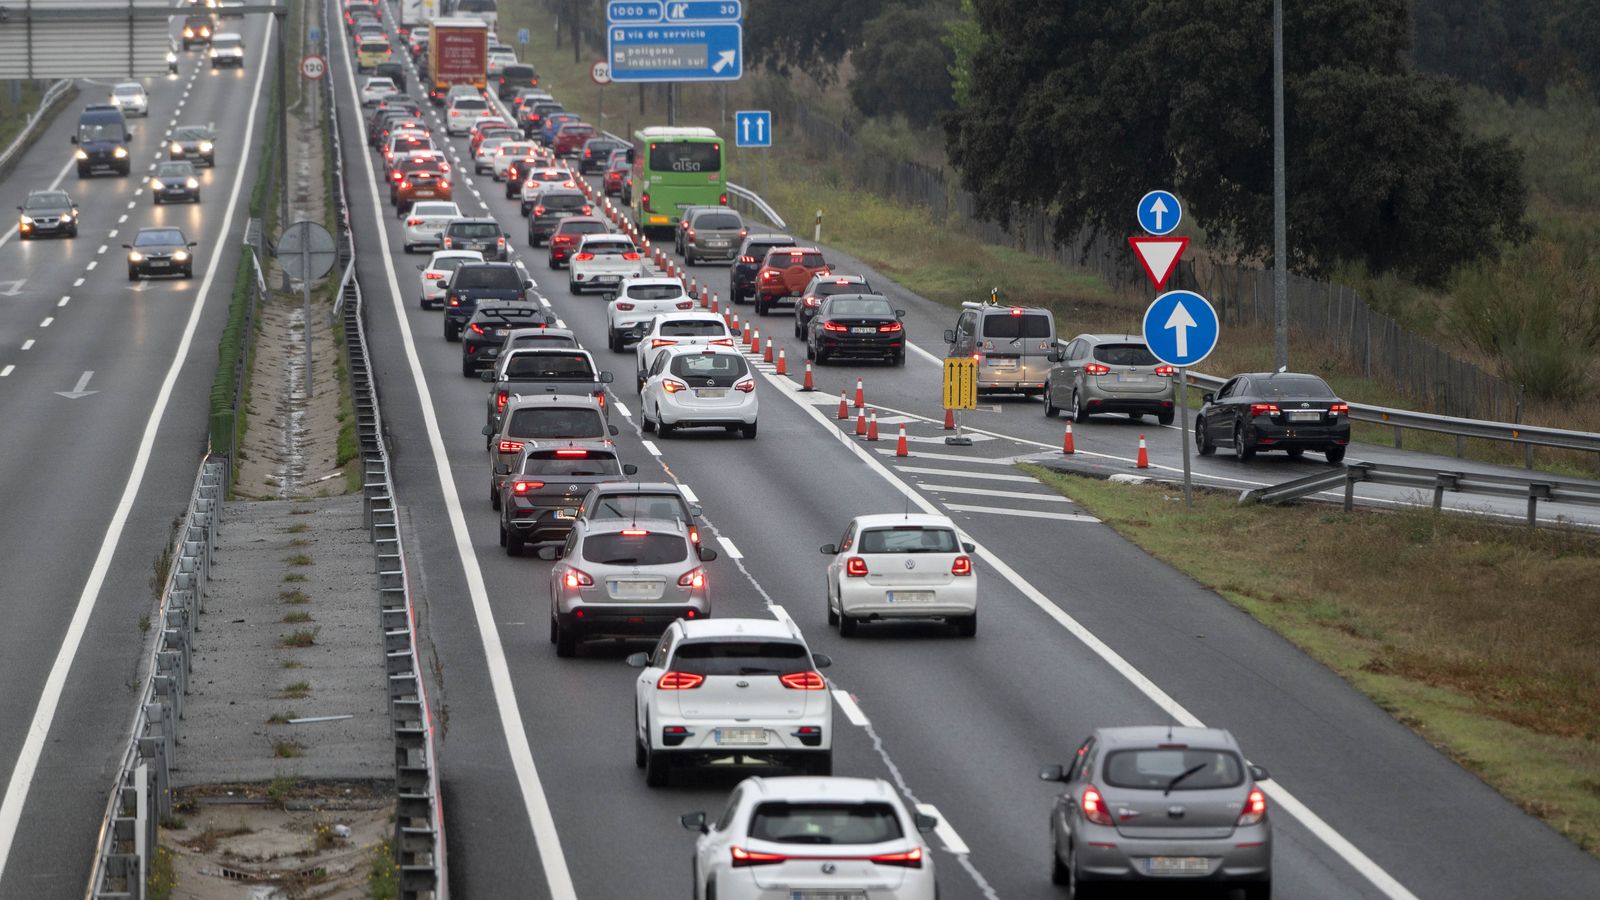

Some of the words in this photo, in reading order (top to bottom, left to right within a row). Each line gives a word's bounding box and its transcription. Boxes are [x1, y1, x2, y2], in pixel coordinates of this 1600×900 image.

[613, 7, 644, 16] 1000
[648, 7, 658, 16] m
[720, 5, 735, 15] 30
[648, 29, 659, 39] de
[663, 29, 706, 39] servicio
[628, 57, 681, 66] industrial
[687, 57, 704, 66] sur
[305, 63, 322, 72] 120
[672, 158, 700, 171] alsa
